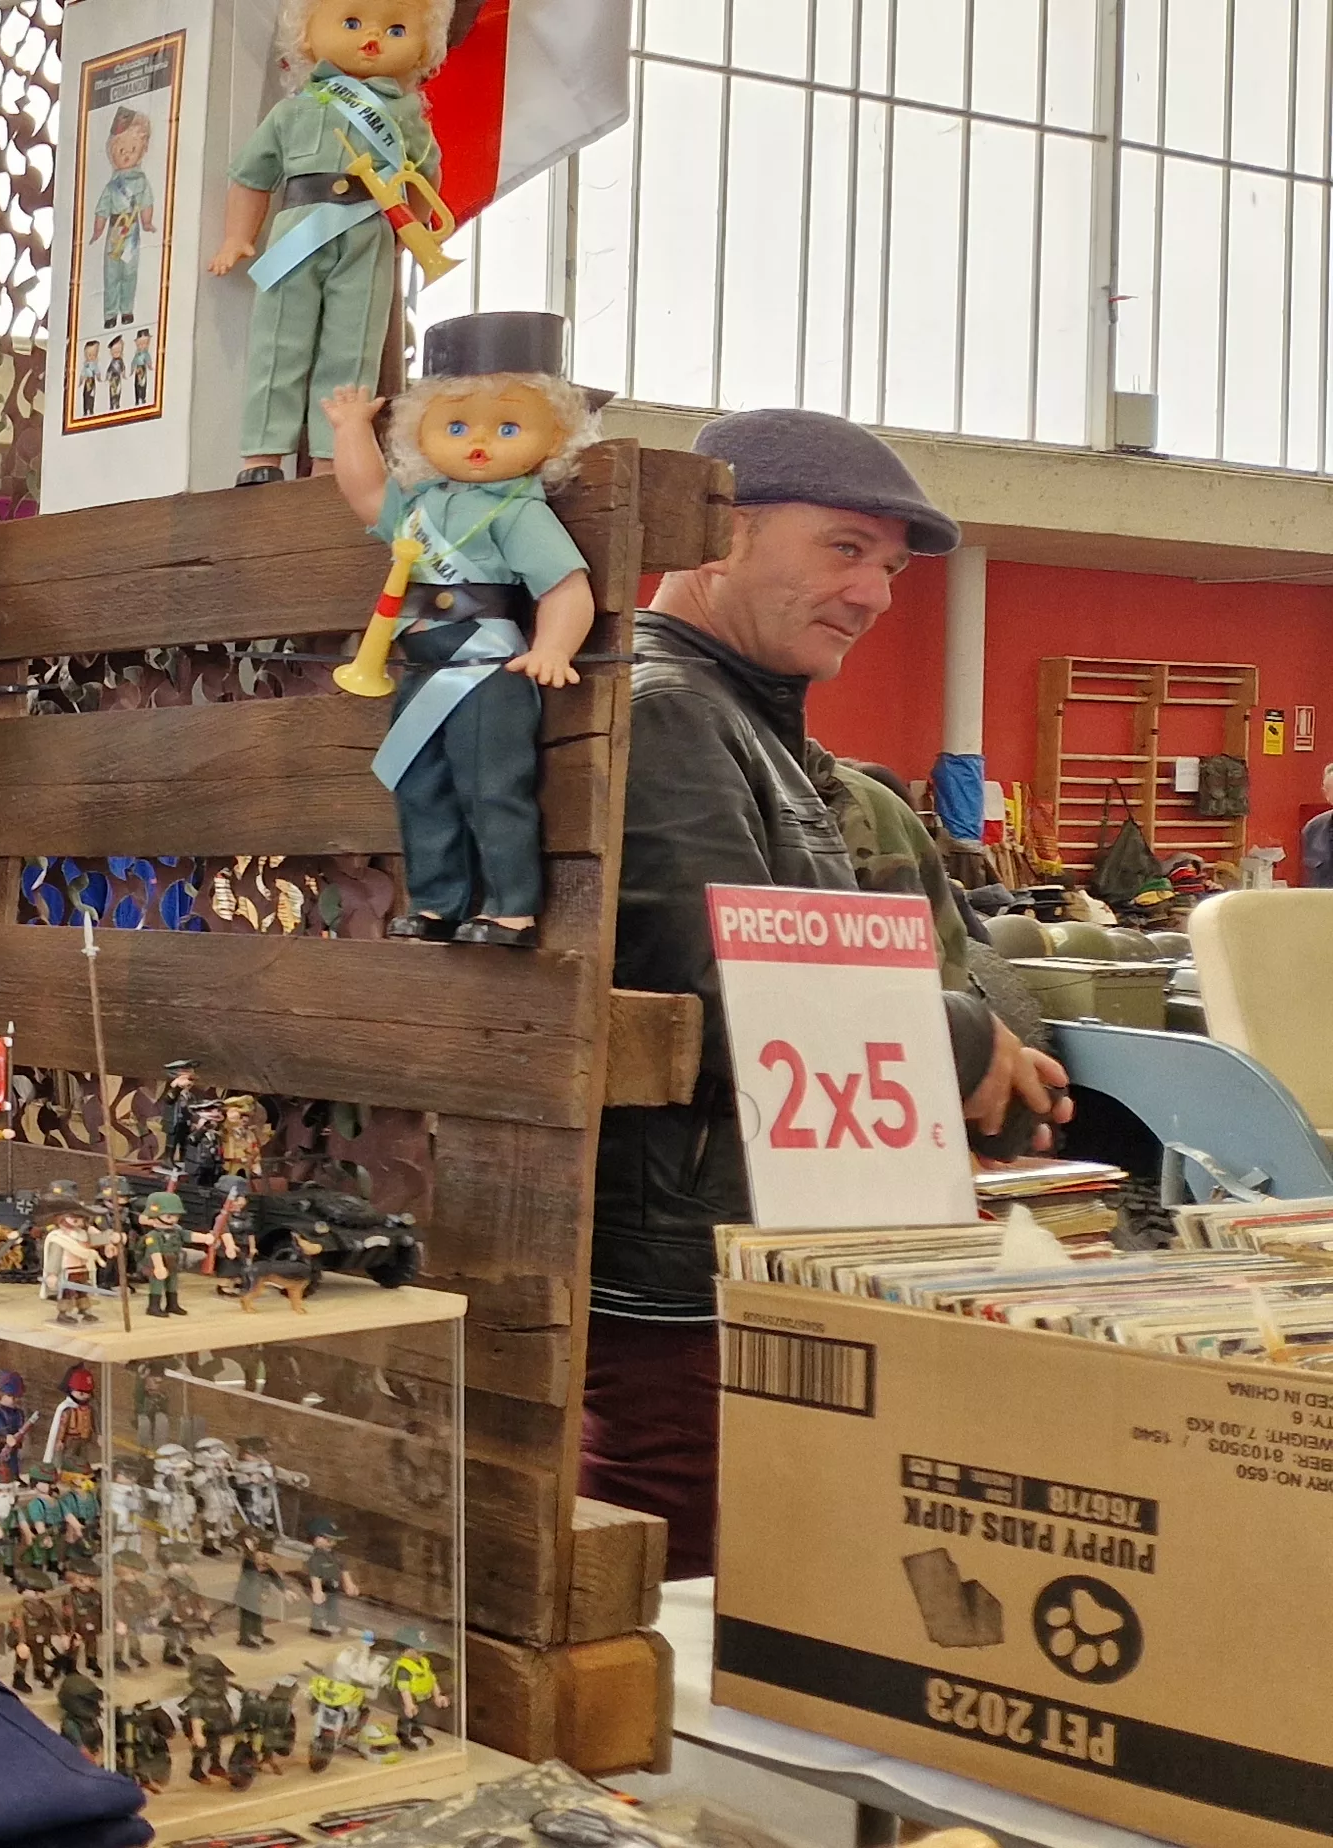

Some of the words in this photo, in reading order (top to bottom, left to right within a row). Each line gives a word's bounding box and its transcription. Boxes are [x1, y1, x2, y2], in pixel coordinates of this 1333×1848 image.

[357, 106, 386, 135] PARA
[382, 132, 395, 148] TI
[719, 906, 829, 947] PRECIO
[834, 912, 928, 951] WOW!
[758, 1039, 919, 1149] 2x5
[1227, 1381, 1280, 1402] CHINA
[1284, 1389, 1301, 1406] IN
[1185, 1416, 1215, 1434] KG
[1292, 1410, 1304, 1425] 6
[1208, 1437, 1283, 1463] 8103503
[1236, 1463, 1269, 1482] 650
[903, 1495, 975, 1537] 40PK
[1047, 1485, 1142, 1529] 766718
[981, 1511, 1057, 1555] PADS
[1062, 1527, 1156, 1575] PUPPY
[926, 1677, 1034, 1745] 2023
[1039, 1708, 1115, 1767] PET
